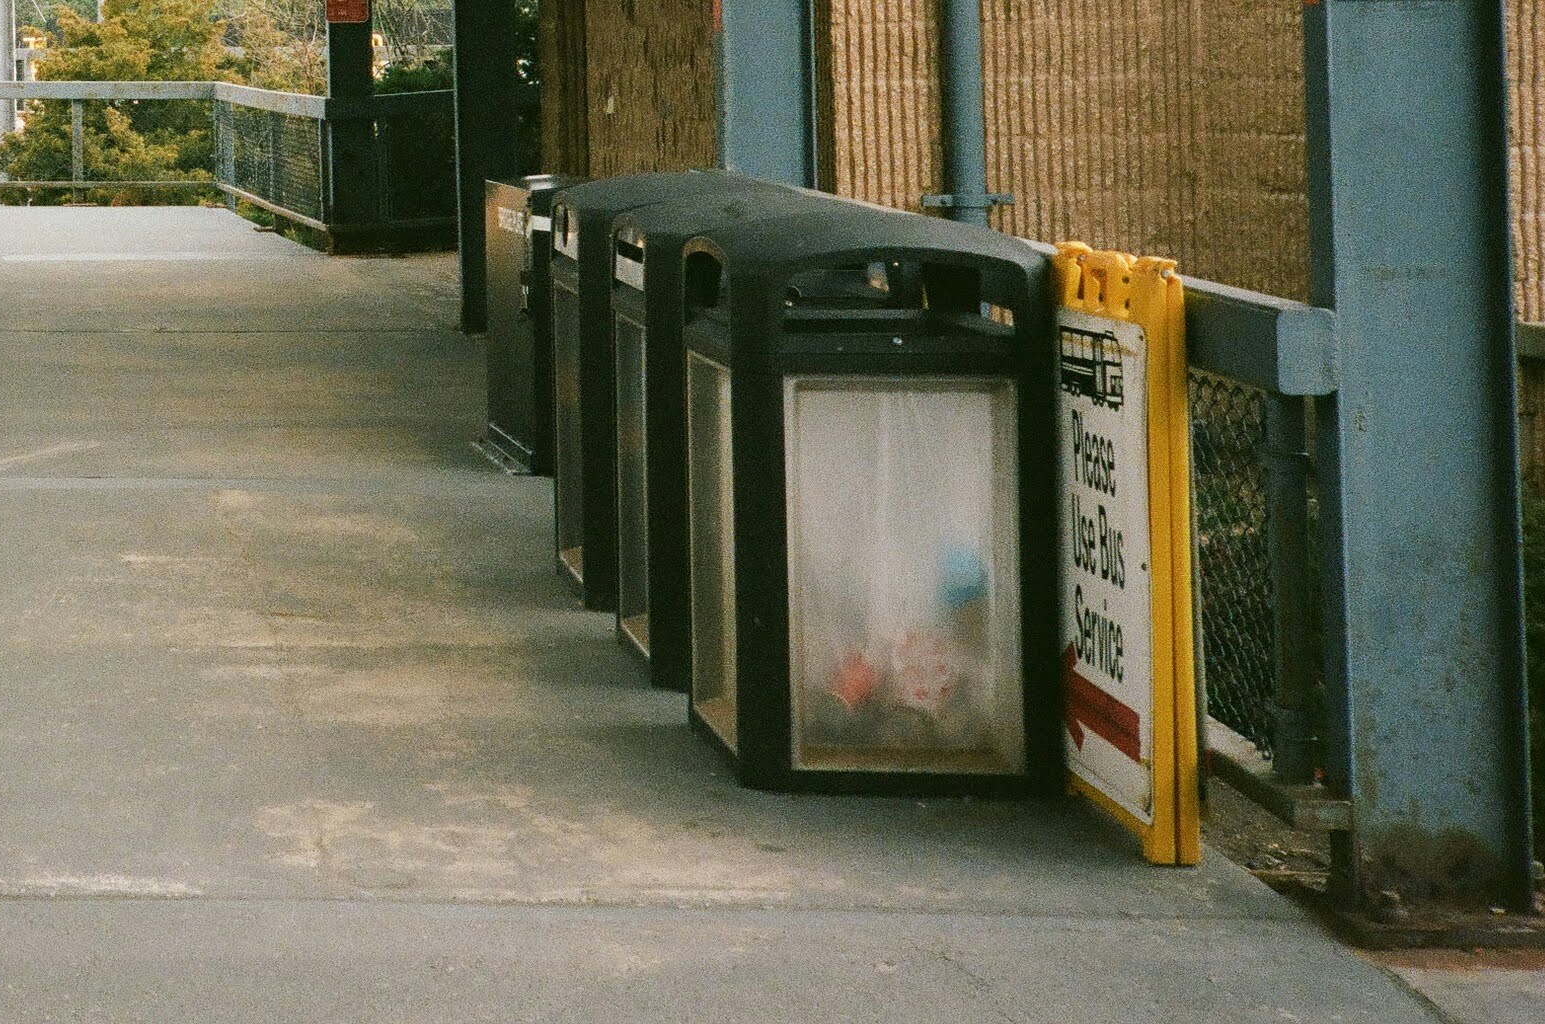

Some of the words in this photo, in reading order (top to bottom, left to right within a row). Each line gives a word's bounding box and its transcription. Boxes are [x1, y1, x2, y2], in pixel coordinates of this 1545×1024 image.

[1071, 408, 1116, 498] Please
[1071, 492, 1098, 572] Use
[1098, 504, 1125, 590] Bus
[1075, 584, 1124, 683] Service
